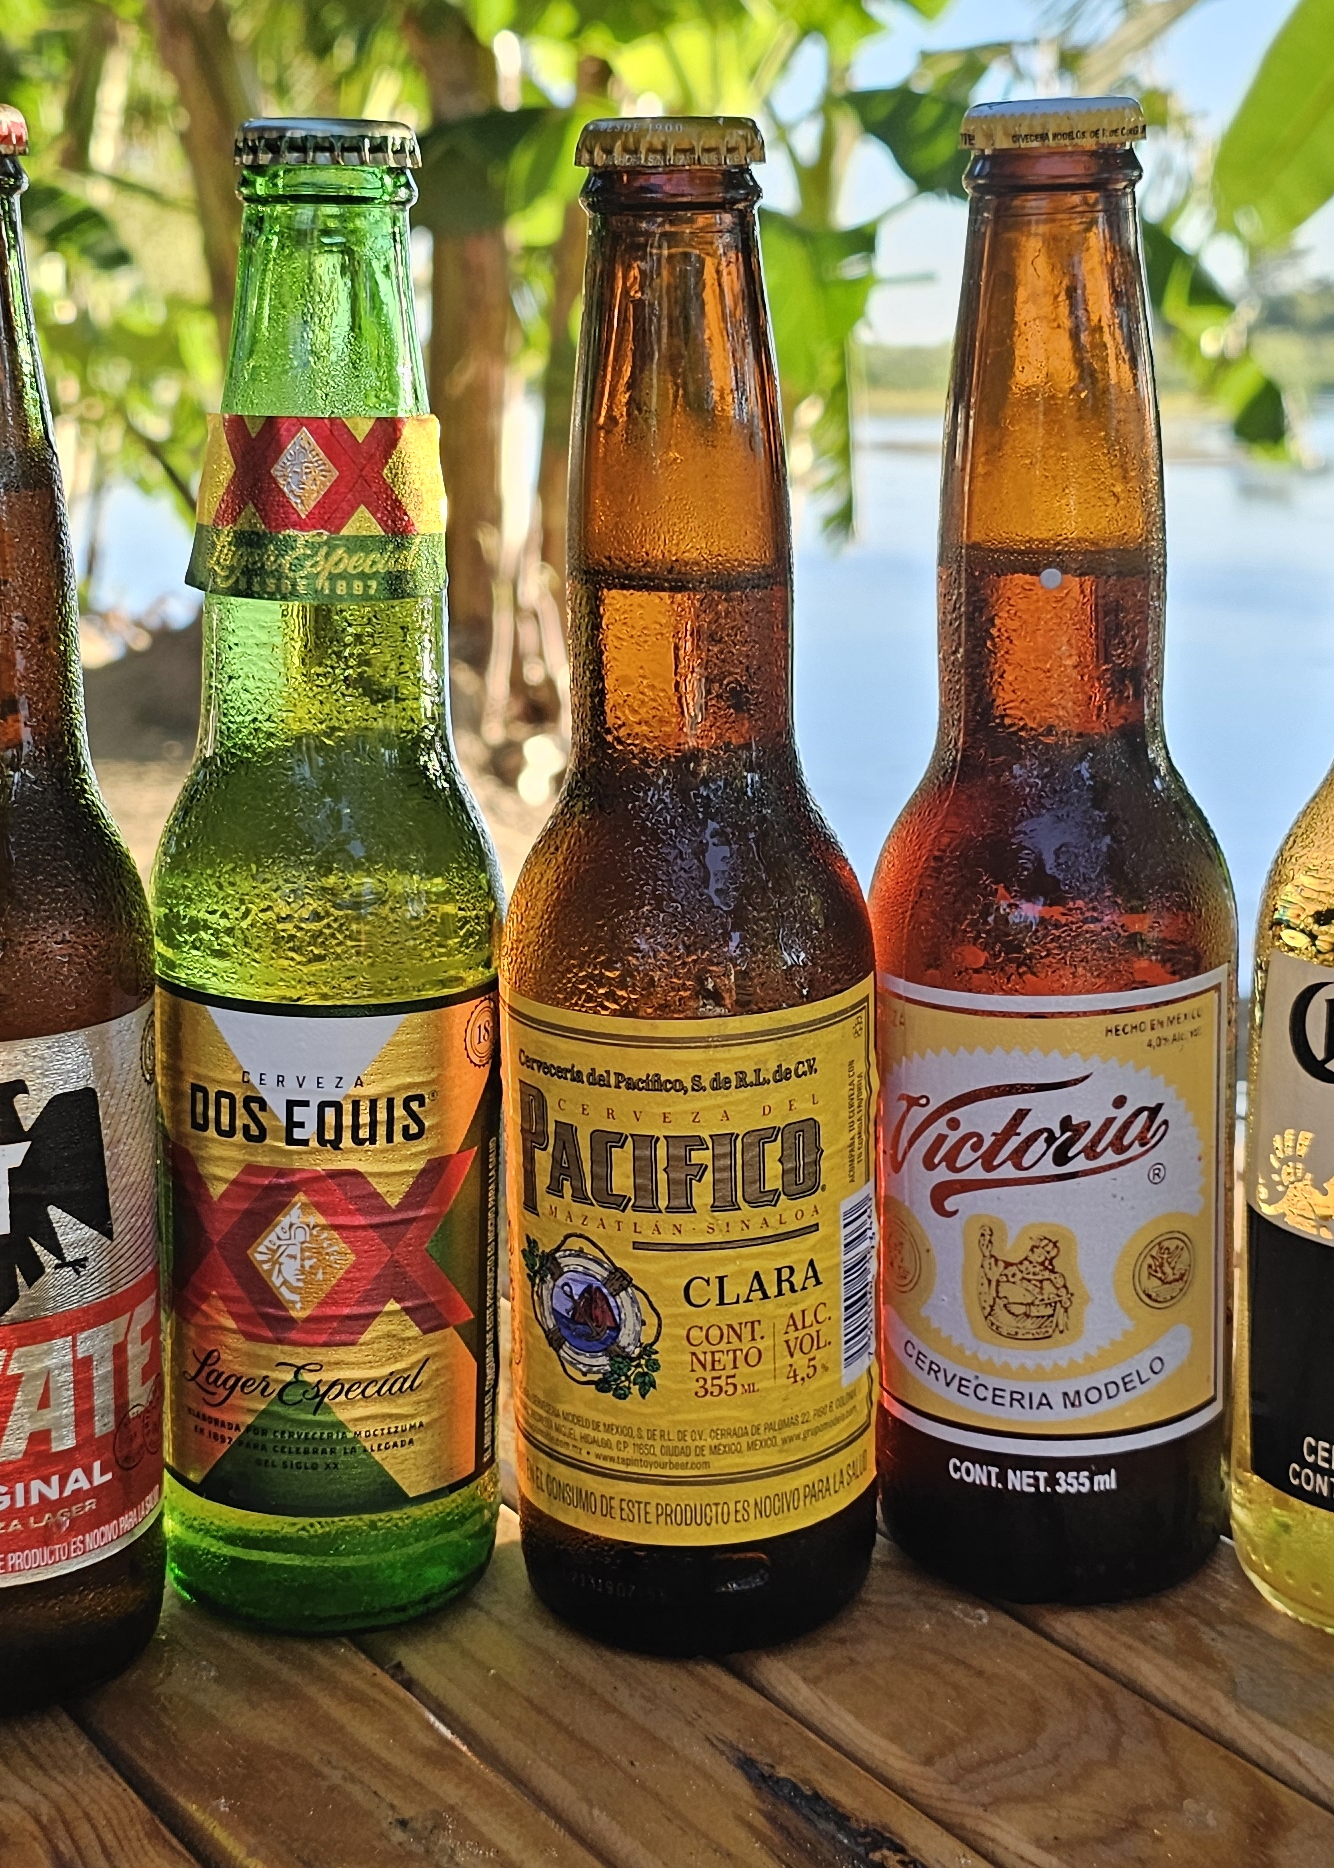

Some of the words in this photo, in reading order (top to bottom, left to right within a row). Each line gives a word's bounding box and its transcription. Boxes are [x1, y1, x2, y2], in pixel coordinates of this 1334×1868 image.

[647, 122, 684, 133] 1900
[213, 416, 419, 536] XX
[1105, 1020, 1147, 1038] HECHO
[1149, 1018, 1165, 1032] EN
[242, 1070, 364, 1089] CERVEZA
[517, 1048, 584, 1082] Cervecería
[587, 1066, 611, 1088] del
[613, 1070, 688, 1096] Pacífico,
[691, 1075, 708, 1093] S.
[709, 1071, 732, 1092] de
[734, 1069, 770, 1089] R.L.
[772, 1063, 793, 1082] de
[793, 1056, 819, 1080] C.V.
[847, 1058, 855, 1078] CON
[558, 1098, 730, 1125] CERVEZA
[761, 1094, 820, 1118] DEL
[847, 1079, 856, 1120] CERVEZA
[190, 1082, 268, 1145] DOS
[284, 1093, 426, 1151] EQUIS
[847, 1120, 856, 1134] TU
[518, 1078, 824, 1217] PACIFICO
[890, 1072, 1169, 1200] Victoria
[706, 1204, 820, 1234] SINALOA
[682, 1258, 823, 1308] CLARA
[685, 1319, 765, 1347] CONT.
[783, 1302, 832, 1335] ALC.
[689, 1346, 763, 1373] NETO
[784, 1330, 832, 1359] VOL.
[182, 1348, 276, 1407] Lager
[274, 1357, 431, 1416] Especial
[694, 1376, 738, 1398] 355
[741, 1381, 760, 1396] ML
[902, 1339, 1054, 1411] CERVECERIA
[1062, 1354, 1166, 1409] MODELO
[353, 1420, 425, 1439] MOCTEZUMA
[646, 1429, 658, 1441] DE
[677, 1430, 688, 1442] DE
[709, 1425, 750, 1442] CERRADA
[750, 1424, 762, 1436] DE
[763, 1414, 800, 1433] PALOMAS
[660, 1444, 692, 1457] CIUDAD
[694, 1444, 706, 1457] DE
[948, 1457, 1002, 1489] CONT.
[1007, 1468, 1052, 1493] NET.
[1055, 1468, 1091, 1494] 355
[1093, 1467, 1117, 1493] ml
[535, 1465, 546, 1493] EL
[546, 1473, 598, 1515] CONSUMO
[600, 1493, 617, 1520] DE
[619, 1498, 653, 1525] ESTE
[655, 1501, 731, 1527] PRODUCTO
[734, 1499, 750, 1524] ES
[753, 1487, 801, 1521] NOCIVO
[803, 1477, 832, 1504] PARA
[832, 1467, 846, 1494] LA
[29, 1498, 98, 1529] LAGER
[8, 1544, 68, 1574] PRODUCTO
[70, 1537, 84, 1557] ES
[84, 1527, 118, 1552] NOCIVO
[117, 1509, 138, 1537] PARA
